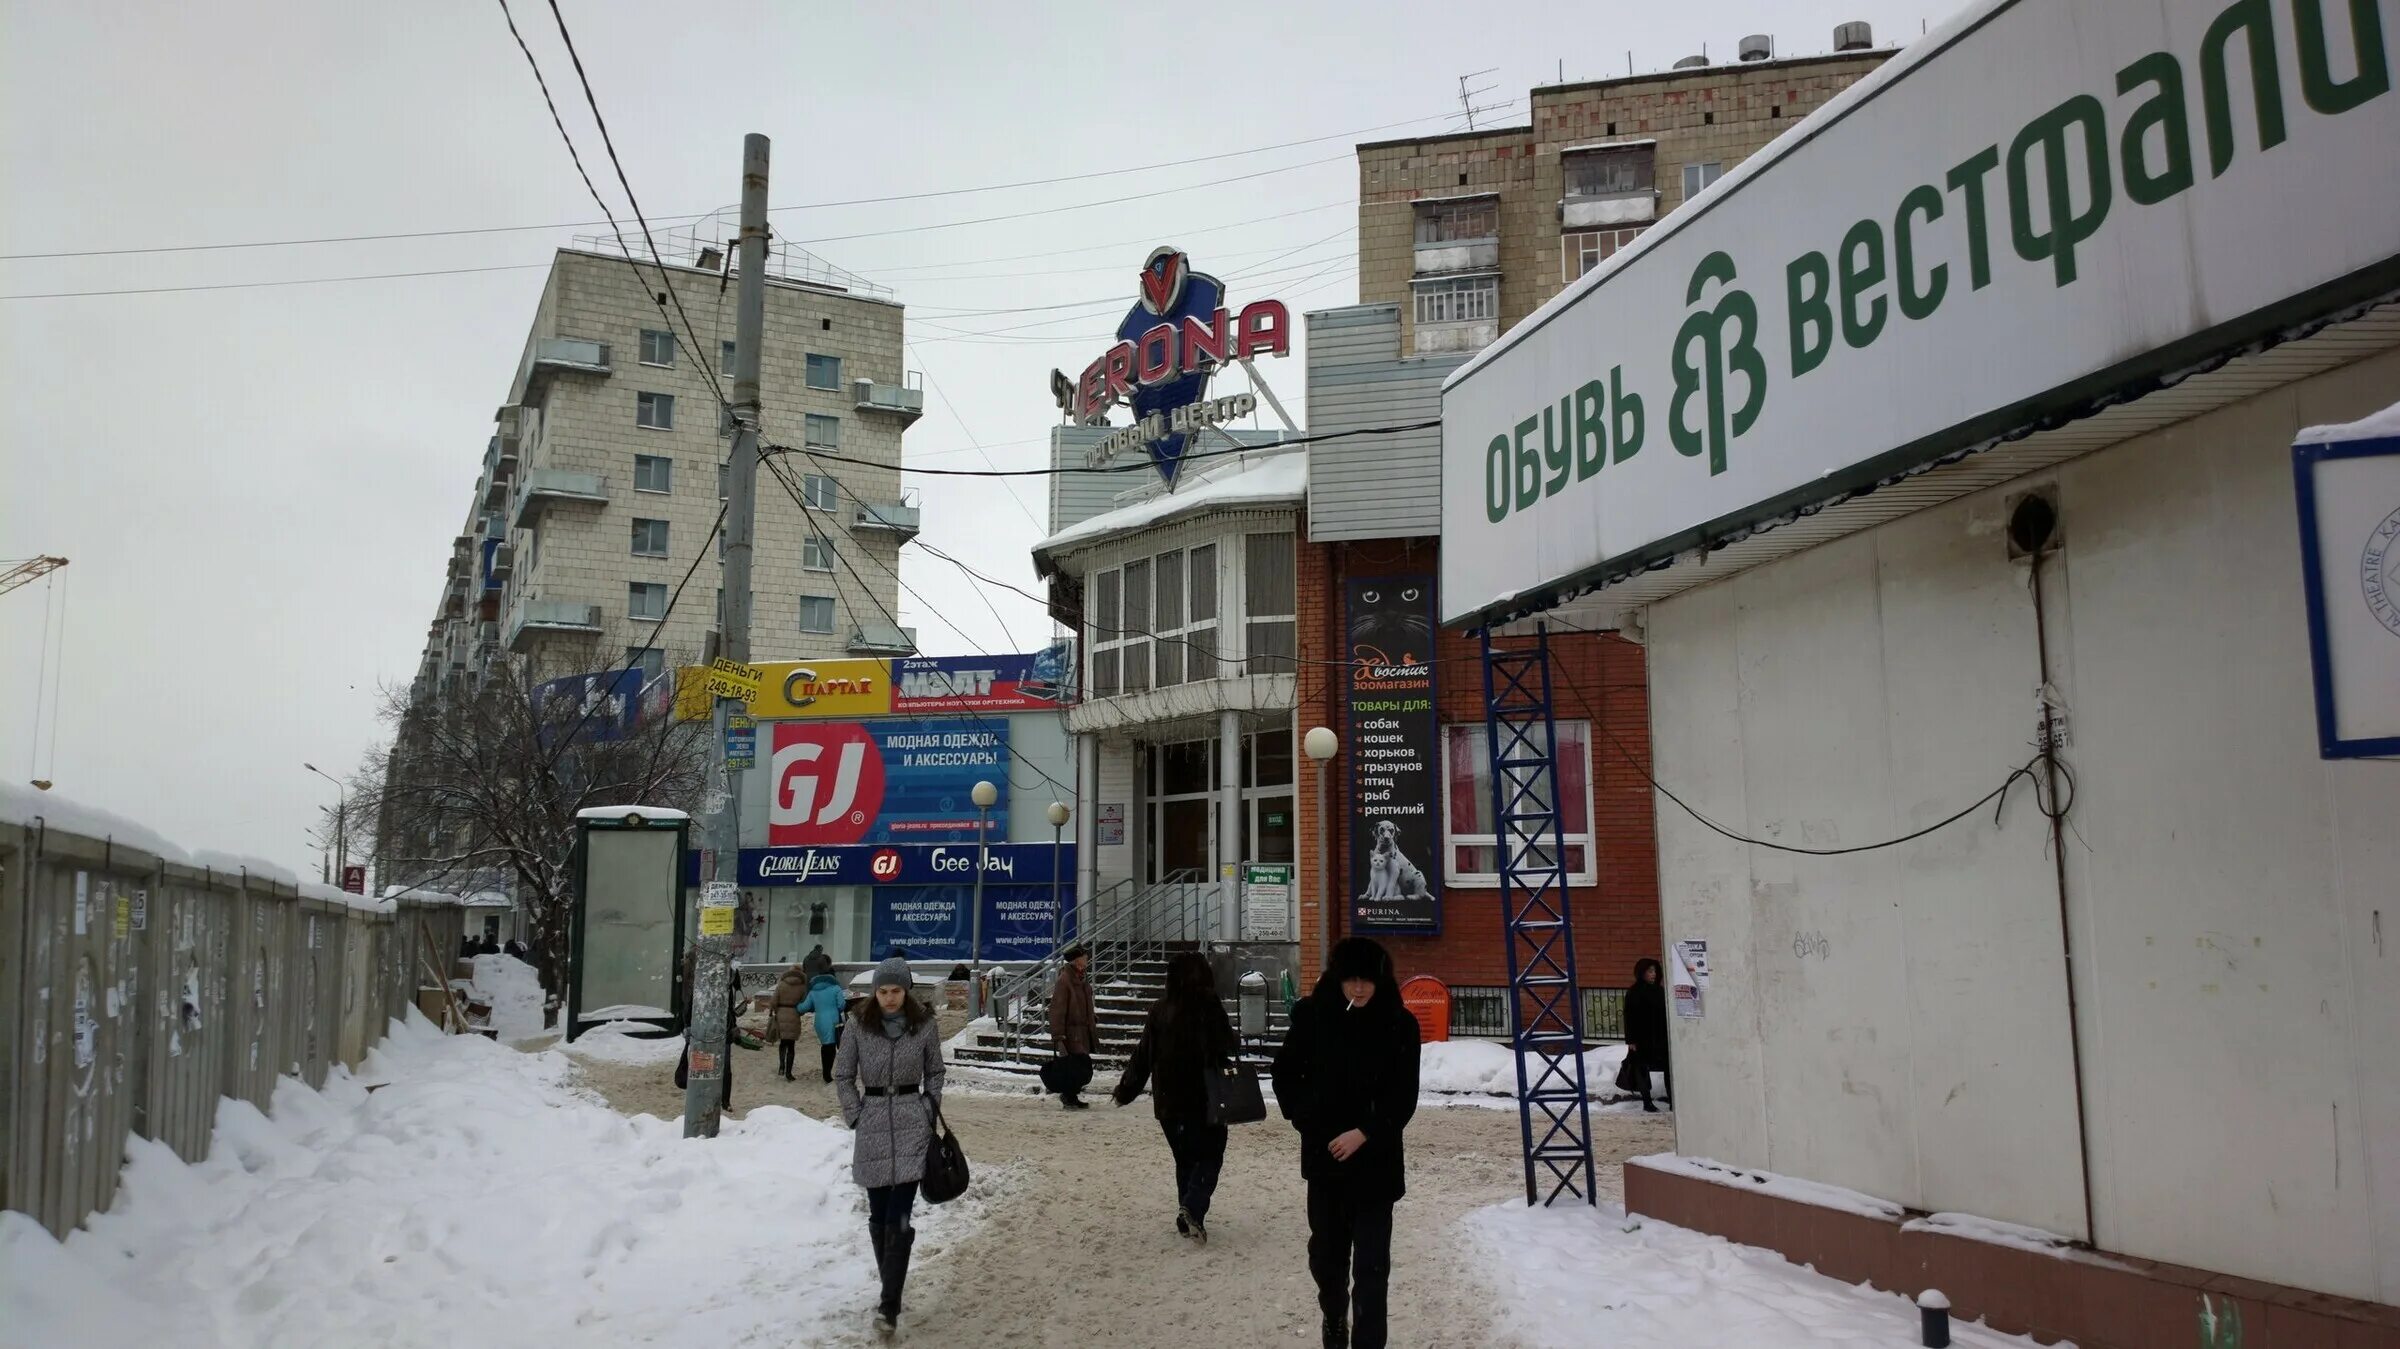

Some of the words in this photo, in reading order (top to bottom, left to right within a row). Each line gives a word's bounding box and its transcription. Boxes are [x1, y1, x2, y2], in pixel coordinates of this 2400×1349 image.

[1170, 393, 1257, 435] ЦЕНТР
[2364, 547, 2388, 613] THEATRE
[713, 659, 763, 682] ДЕНЬГИ
[708, 678, 757, 702] 249-18-93
[1353, 680, 1430, 690] зоомагазин
[982, 698, 1025, 706] ОРГТЕХНИКА
[1351, 701, 1400, 711] ТОВАРЫ
[1402, 700, 1432, 712] ДЛЯ:
[1363, 718, 1400, 729] собак
[887, 735, 940, 750] МОДНАЯ
[943, 733, 998, 749] ОДЕЖДА
[1363, 734, 1404, 743] кошек
[1364, 748, 1415, 760] хорьков
[903, 754, 912, 767] И
[1364, 763, 1423, 774] грызунов
[1364, 777, 1395, 788] птиц
[1364, 790, 1390, 802] рыб
[1364, 803, 1425, 817] рептилий
[931, 848, 970, 872] Gee
[975, 847, 1013, 880] Jay
[890, 902, 922, 912] МОДНАЯ
[923, 901, 956, 911] ОДЕЖДА
[996, 901, 1028, 911] МОДНАЯ
[902, 913, 951, 922] АКСЕССУАРЫ
